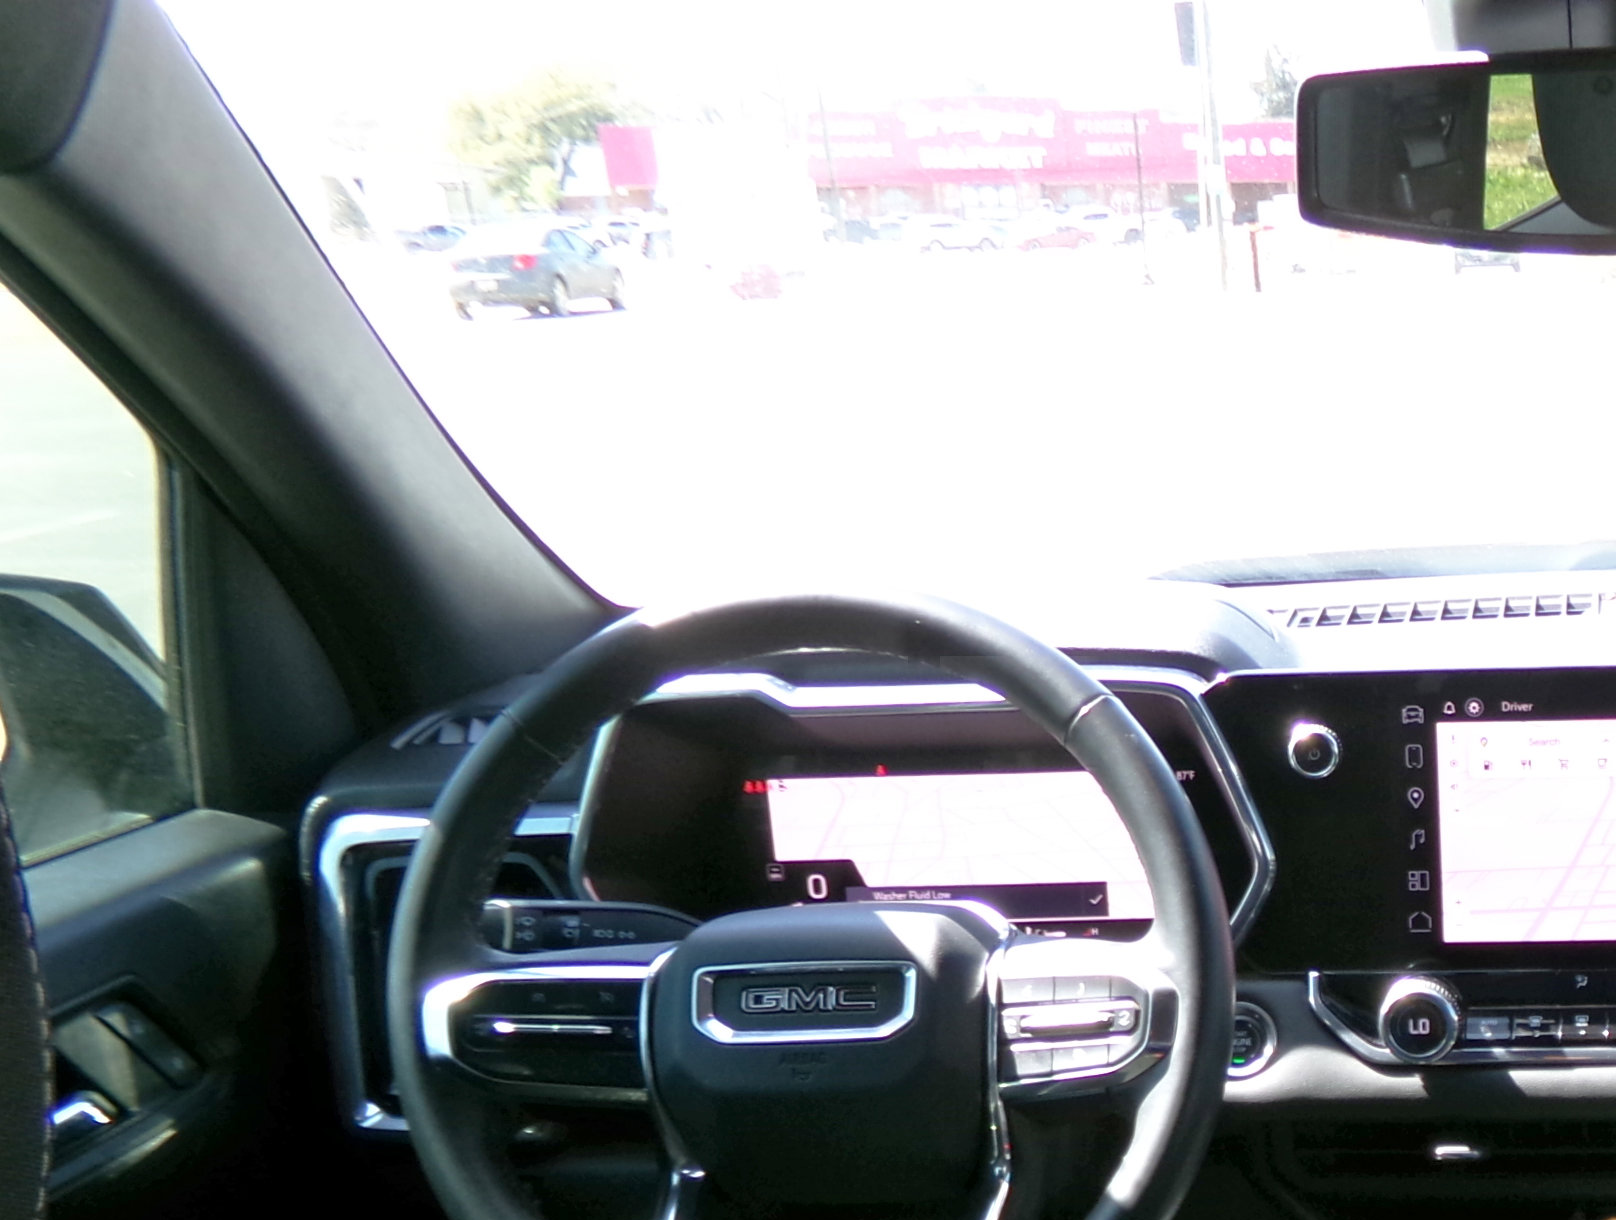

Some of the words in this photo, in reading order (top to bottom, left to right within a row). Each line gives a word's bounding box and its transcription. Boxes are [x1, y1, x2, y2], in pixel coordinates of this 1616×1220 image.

[1501, 701, 1534, 712] Driver
[1528, 737, 1561, 747] Search
[807, 874, 828, 899] 0
[873, 891, 907, 900] Washer
[908, 890, 931, 900] Fluid
[932, 890, 952, 899] Low
[741, 986, 877, 1013] GMC
[1409, 1018, 1430, 1035] LO
